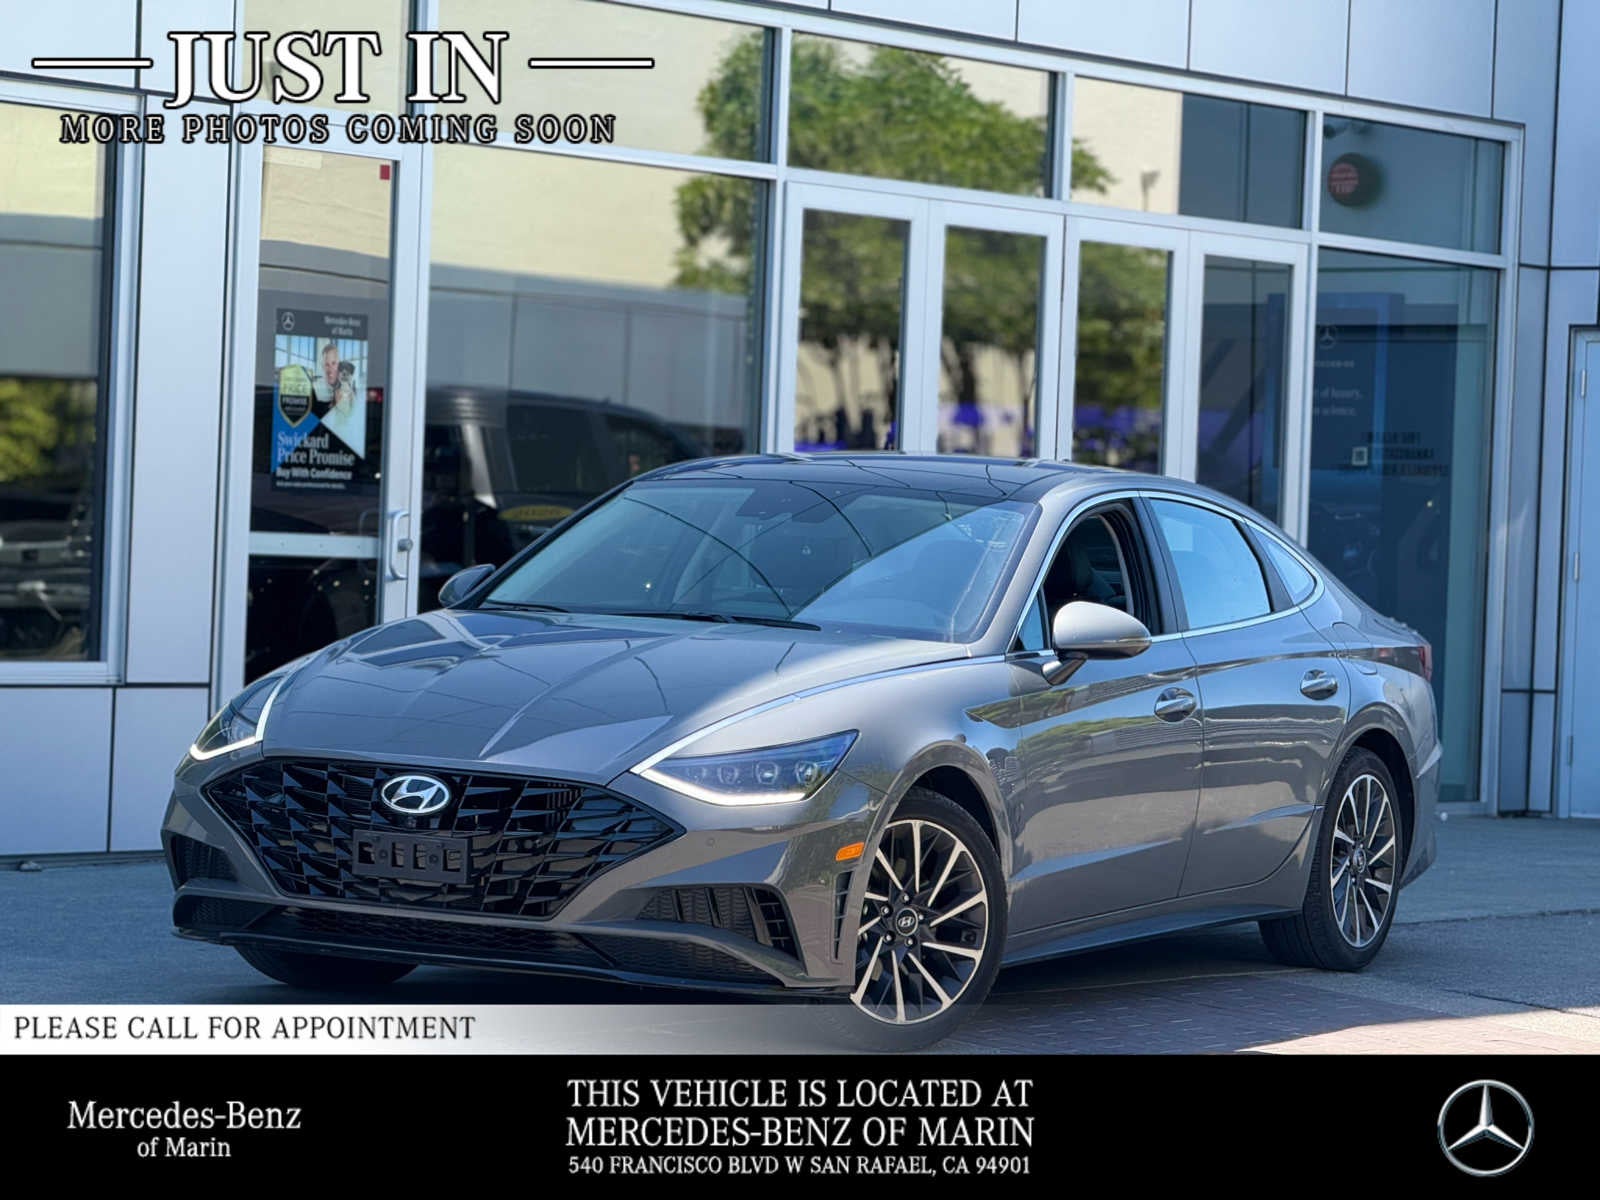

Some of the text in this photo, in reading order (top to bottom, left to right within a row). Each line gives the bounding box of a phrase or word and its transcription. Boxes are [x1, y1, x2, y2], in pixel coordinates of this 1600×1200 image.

[277, 431, 329, 449] Swickard
[277, 447, 355, 466] Price Promise
[276, 466, 290, 479] Buy
[311, 467, 352, 480] Confidence
